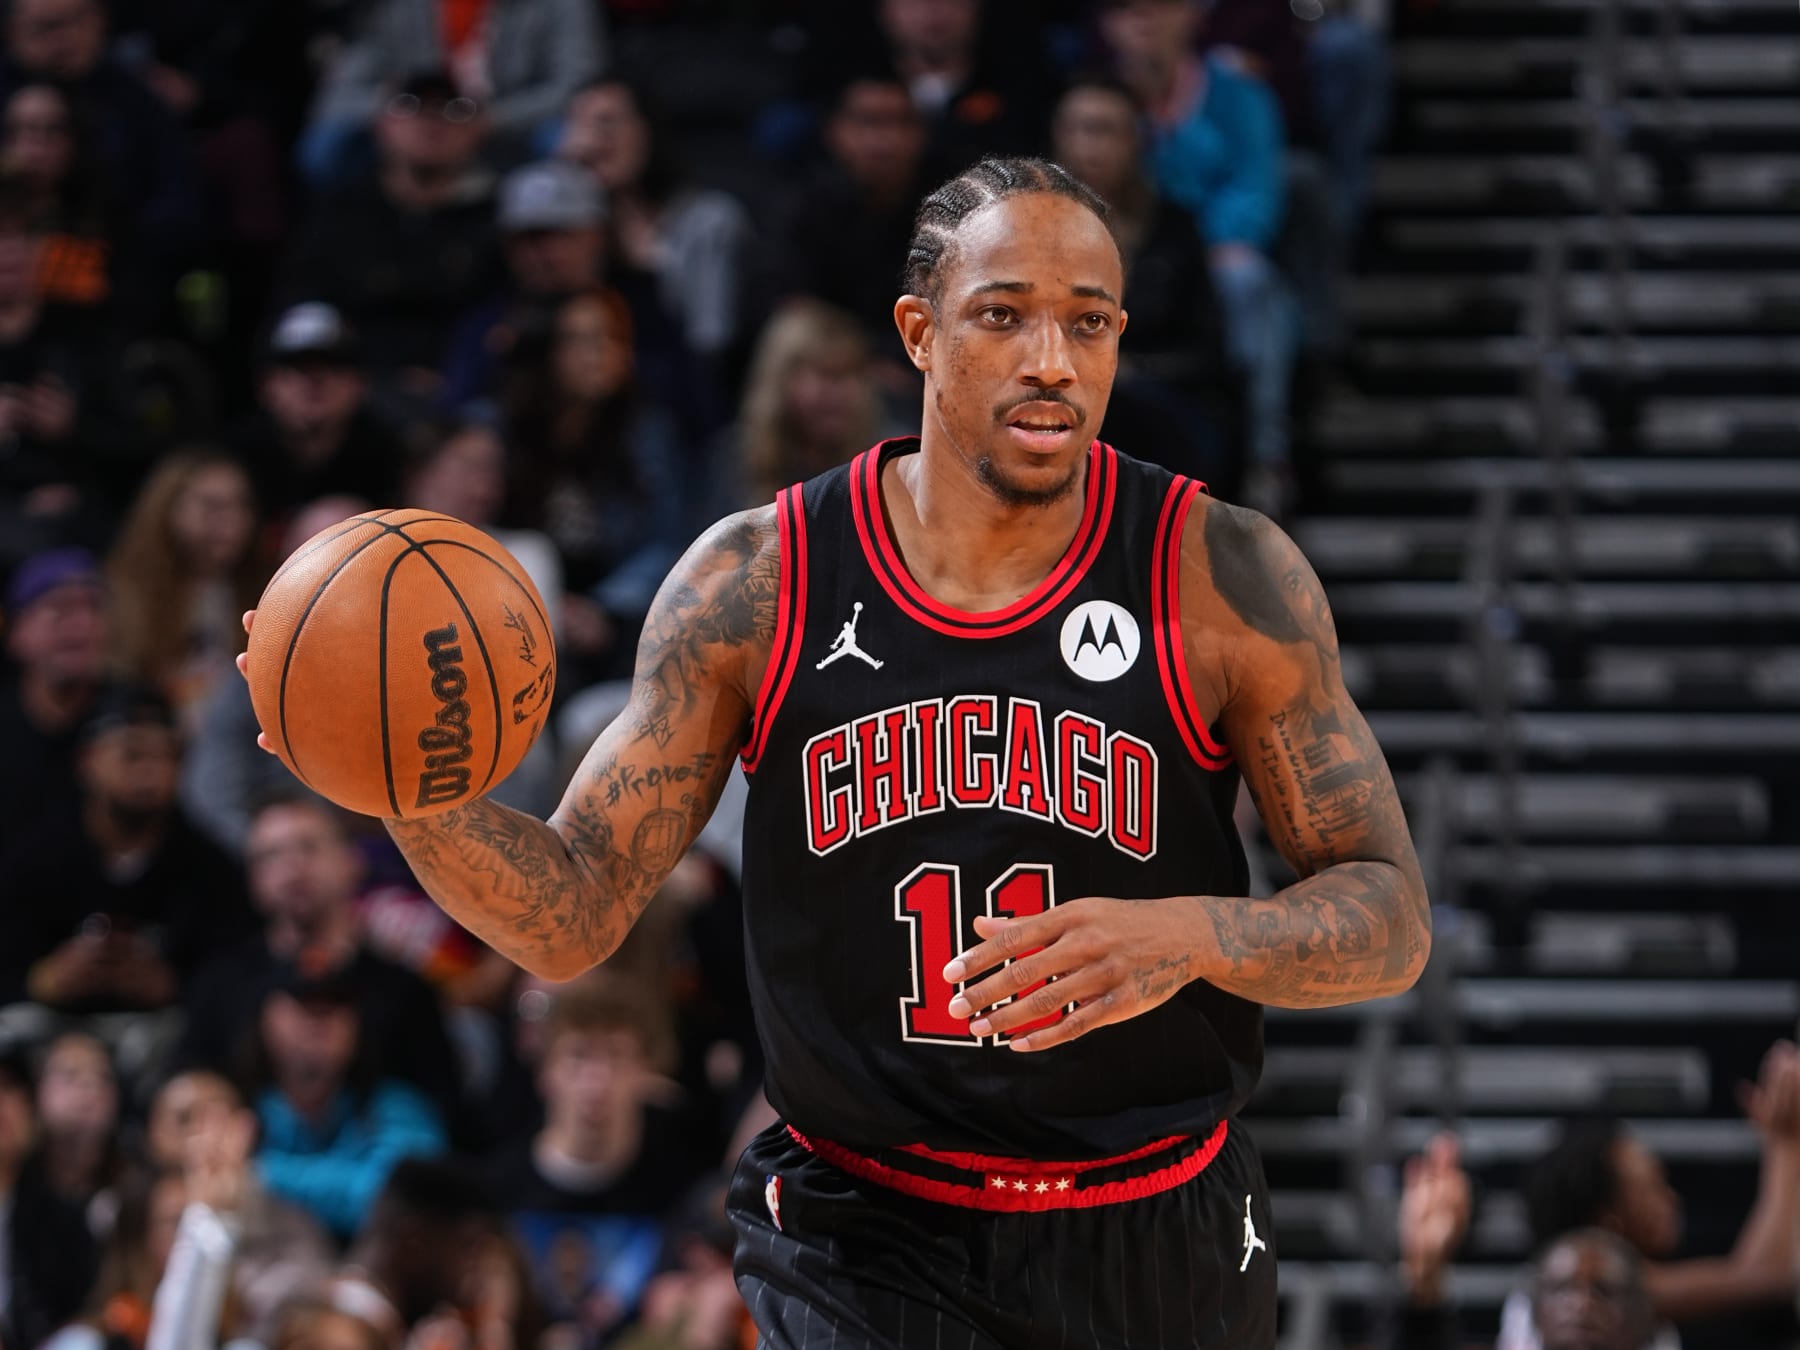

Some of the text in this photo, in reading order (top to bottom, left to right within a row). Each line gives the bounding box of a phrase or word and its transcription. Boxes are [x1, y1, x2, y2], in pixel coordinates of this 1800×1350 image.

[414, 622, 474, 810] Wilson
[802, 694, 1159, 862] CHICAGO
[894, 862, 1075, 1047] 11
